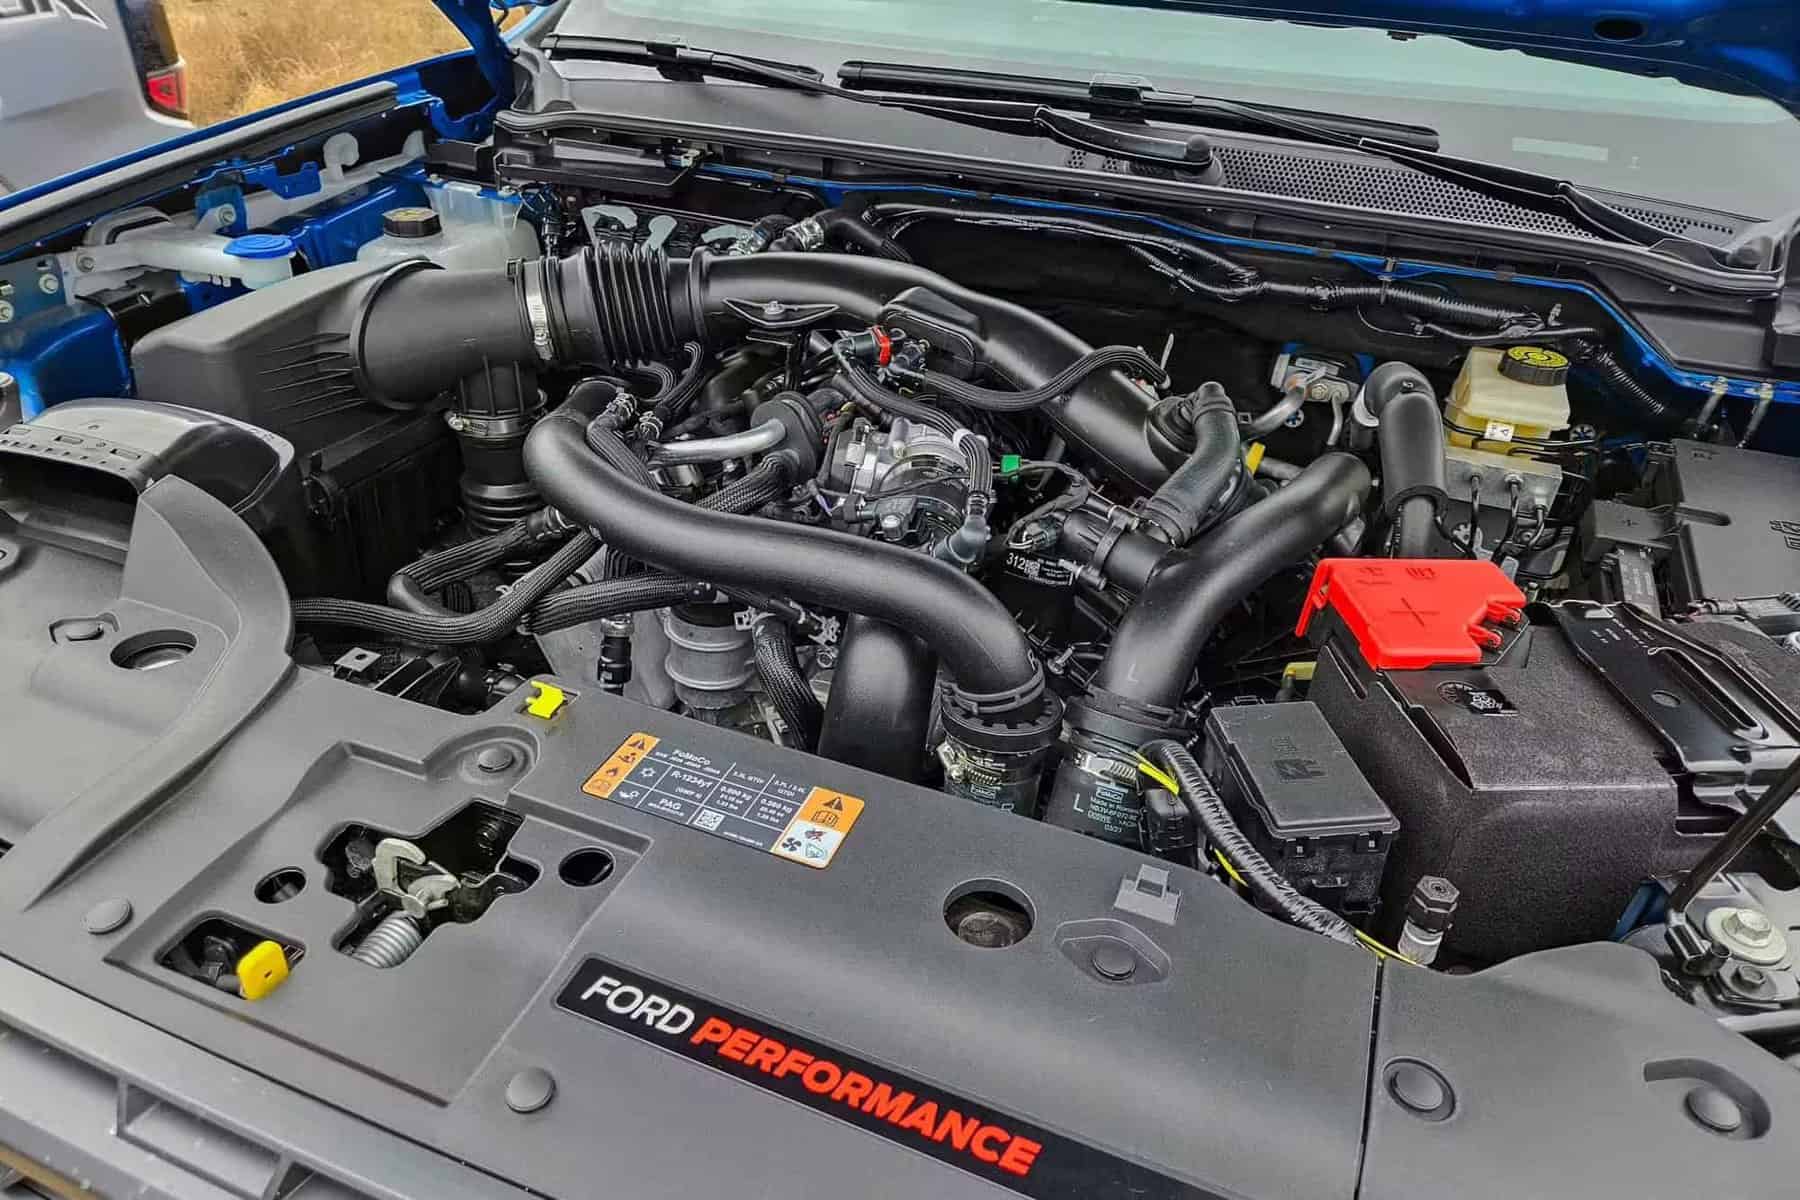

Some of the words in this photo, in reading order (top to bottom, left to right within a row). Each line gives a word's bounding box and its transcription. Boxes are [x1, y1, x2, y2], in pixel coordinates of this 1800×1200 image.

[1006, 552, 1026, 570] 312
[672, 749, 711, 765] FoMoCo
[671, 770, 713, 788] R-1234yf
[659, 798, 681, 810] PAG
[1073, 792, 1084, 813] L
[581, 975, 694, 1035] FORD
[690, 1016, 1042, 1176] PERFORMANCE
